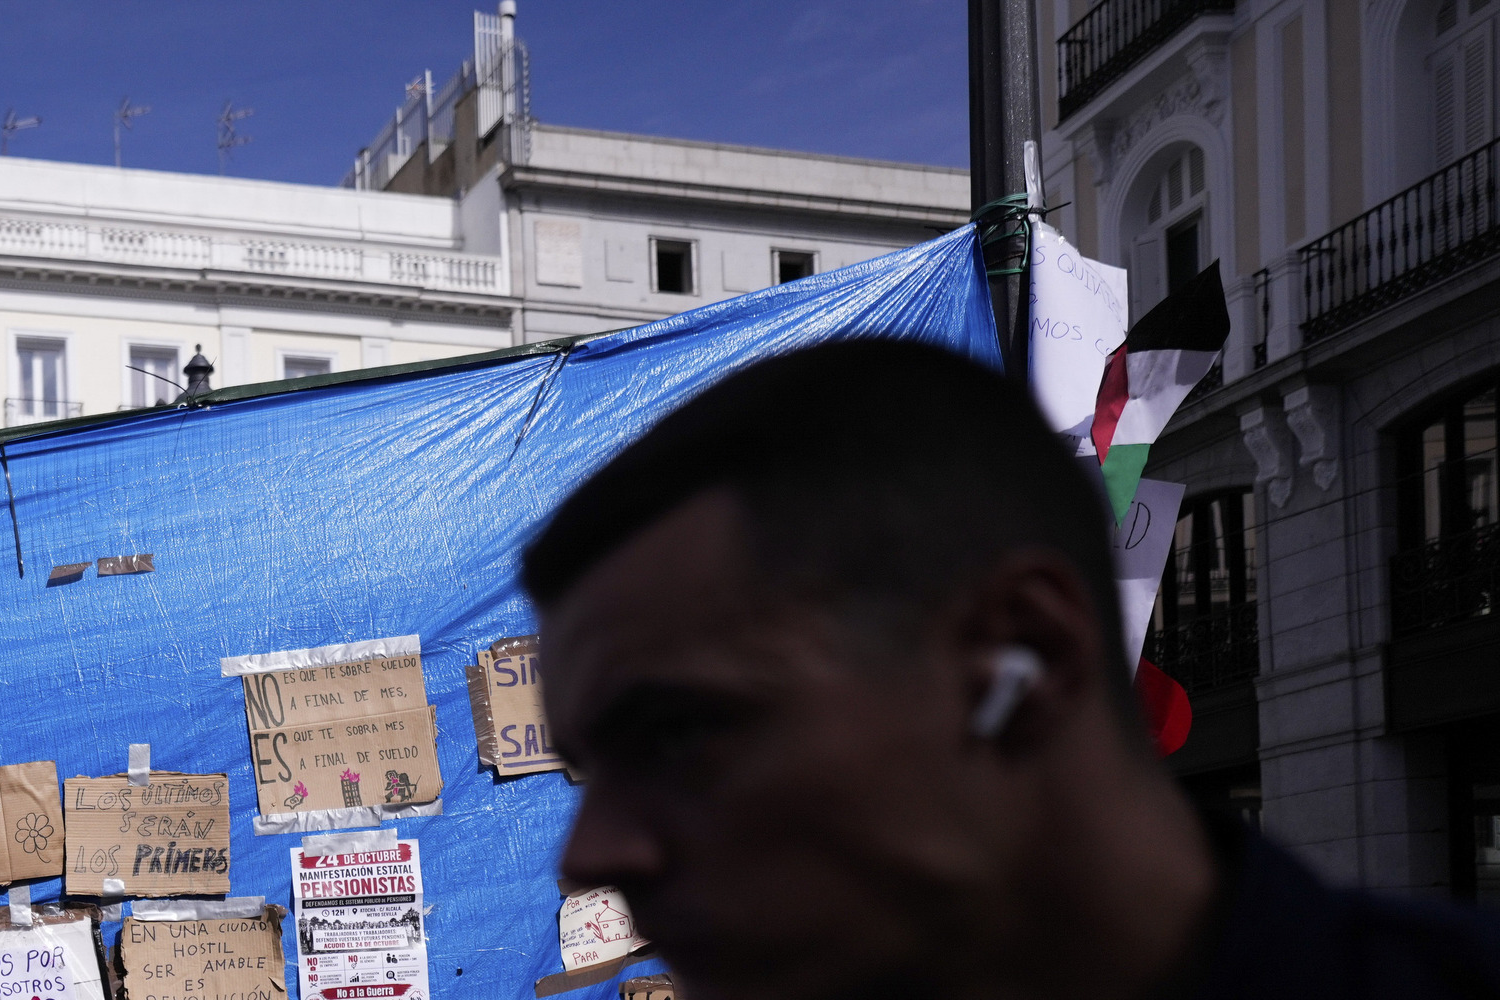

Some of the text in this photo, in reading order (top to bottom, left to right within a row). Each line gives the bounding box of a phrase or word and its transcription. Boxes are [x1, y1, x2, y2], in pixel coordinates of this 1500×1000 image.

[245, 656, 417, 730] NO ES QUE TE SOBRE SUELDO
[289, 686, 408, 711] A FINAL DE MES,
[254, 720, 405, 785] ES QUE TE SOBRA MES
[299, 745, 419, 771] A FINAL DE SUELDO
[343, 853, 356, 865] DE
[358, 849, 402, 864] OCTUBRE
[299, 864, 414, 882] MANIFESTACIÓN ESTATAL
[300, 875, 416, 898] PENSIONISTAS
[331, 908, 345, 917] 12H
[336, 988, 348, 999] No
[356, 988, 365, 997] la
[366, 986, 395, 998] Guerra
